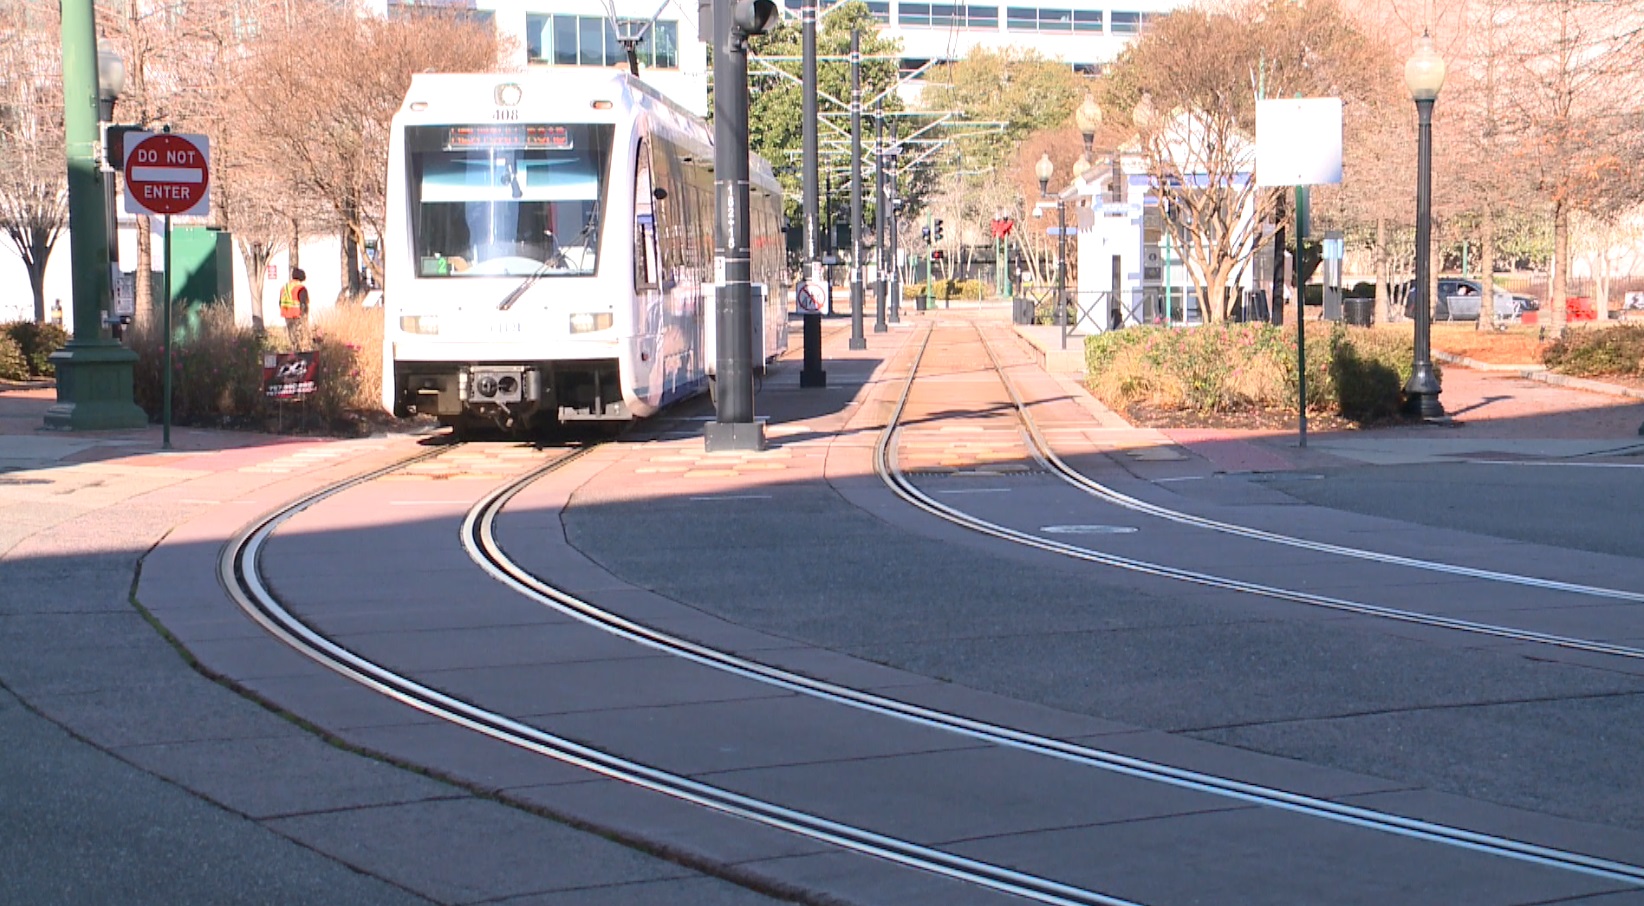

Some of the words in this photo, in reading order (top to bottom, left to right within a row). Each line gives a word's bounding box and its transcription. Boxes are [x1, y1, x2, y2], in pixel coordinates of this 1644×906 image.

[492, 109, 519, 120] 408
[138, 149, 158, 163] DO
[166, 150, 196, 164] NOT
[144, 184, 190, 199] ENTER
